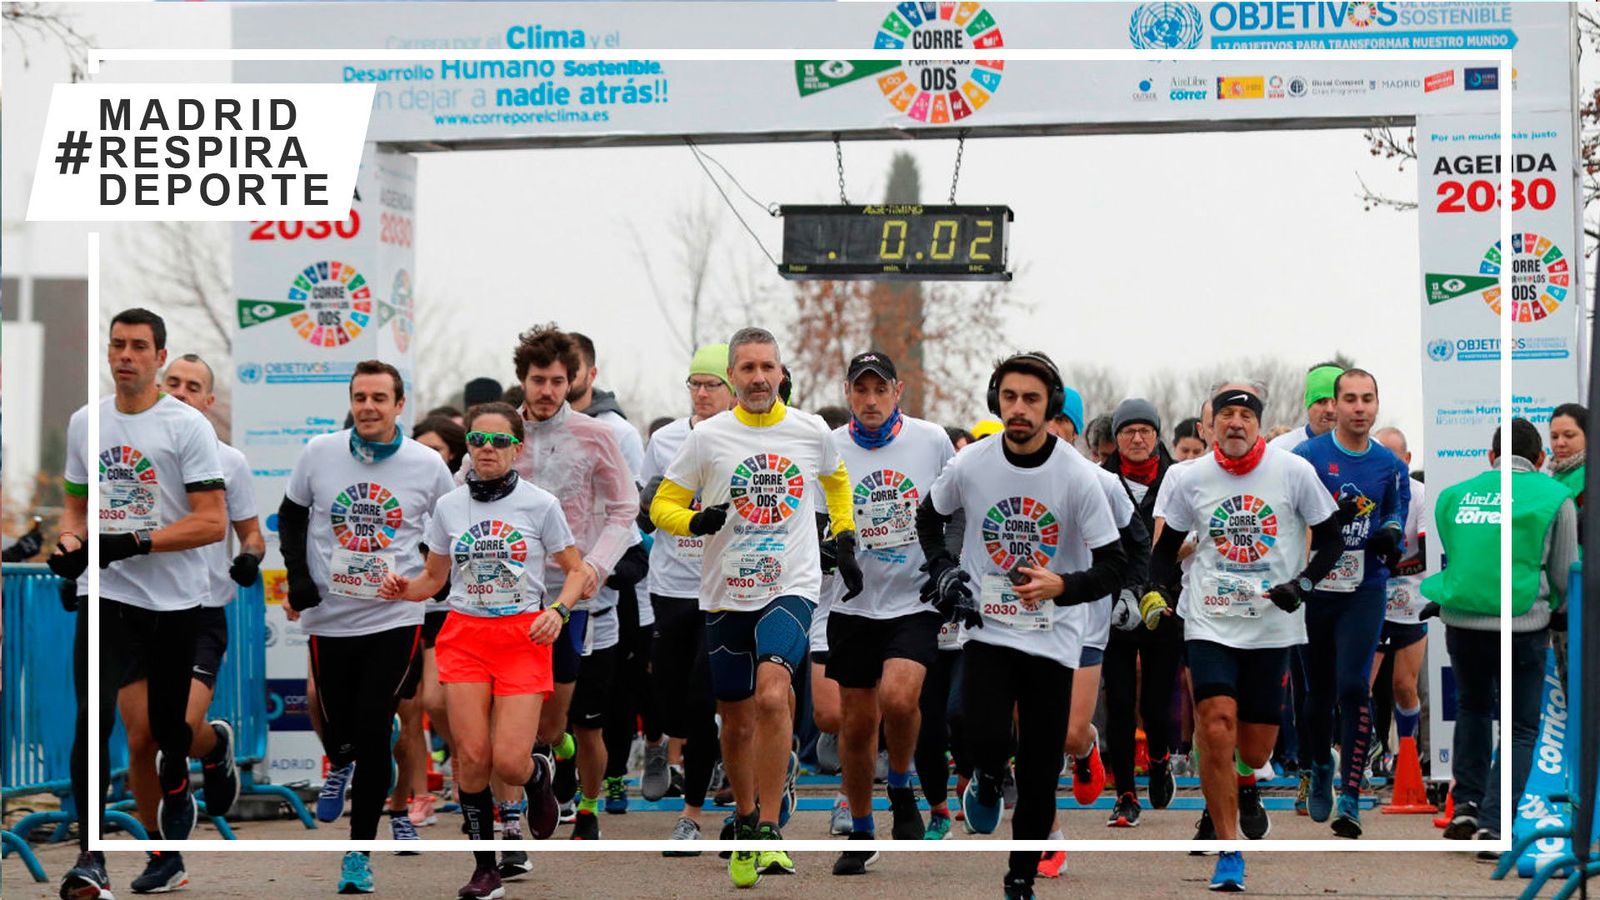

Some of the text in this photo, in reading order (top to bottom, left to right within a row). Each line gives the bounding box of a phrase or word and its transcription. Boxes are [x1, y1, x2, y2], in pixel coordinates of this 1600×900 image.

[1400, 8, 1512, 26] SOSTENIBLE
[506, 25, 586, 49] Clima
[912, 29, 963, 49] CORRE
[1328, 38, 1410, 49] TRANSFORMAR
[1413, 37, 1464, 48] NUESTRO
[1467, 35, 1508, 46] MUNDO
[343, 65, 434, 83] Desarrollo
[440, 60, 555, 80] Humano
[921, 67, 957, 90] ODS
[1381, 80, 1420, 89] MADRID
[400, 89, 460, 114] dejar
[471, 93, 486, 109] a
[496, 82, 570, 107] nadie
[1170, 90, 1207, 101] correr
[1431, 133, 1448, 142] Por
[1532, 130, 1557, 140] justo
[884, 264, 899, 272] min.
[1533, 275, 1545, 283] LOS
[317, 311, 341, 325] ODS
[265, 362, 329, 374] OBJETIVOS
[107, 468, 135, 481] CORRE
[753, 473, 782, 485] CORRE
[750, 486, 762, 494] POR
[871, 489, 898, 502] CORRE
[757, 495, 778, 507] ODS
[352, 503, 380, 516] CORRE
[1005, 520, 1036, 533] CORRE
[1229, 515, 1257, 526] CORRE
[355, 524, 375, 536] ODS
[861, 526, 888, 537] 2030
[1002, 533, 1014, 541] POR
[1234, 535, 1253, 546] ODS
[475, 540, 504, 551] CORRE
[678, 539, 703, 548] 2030
[1009, 542, 1032, 555] ODS
[333, 573, 362, 586] 2030
[727, 577, 755, 588] 2030
[467, 584, 493, 594] 2030
[1204, 596, 1230, 606] 2030
[984, 604, 1017, 616] 2030
[271, 759, 316, 770] ADRID
